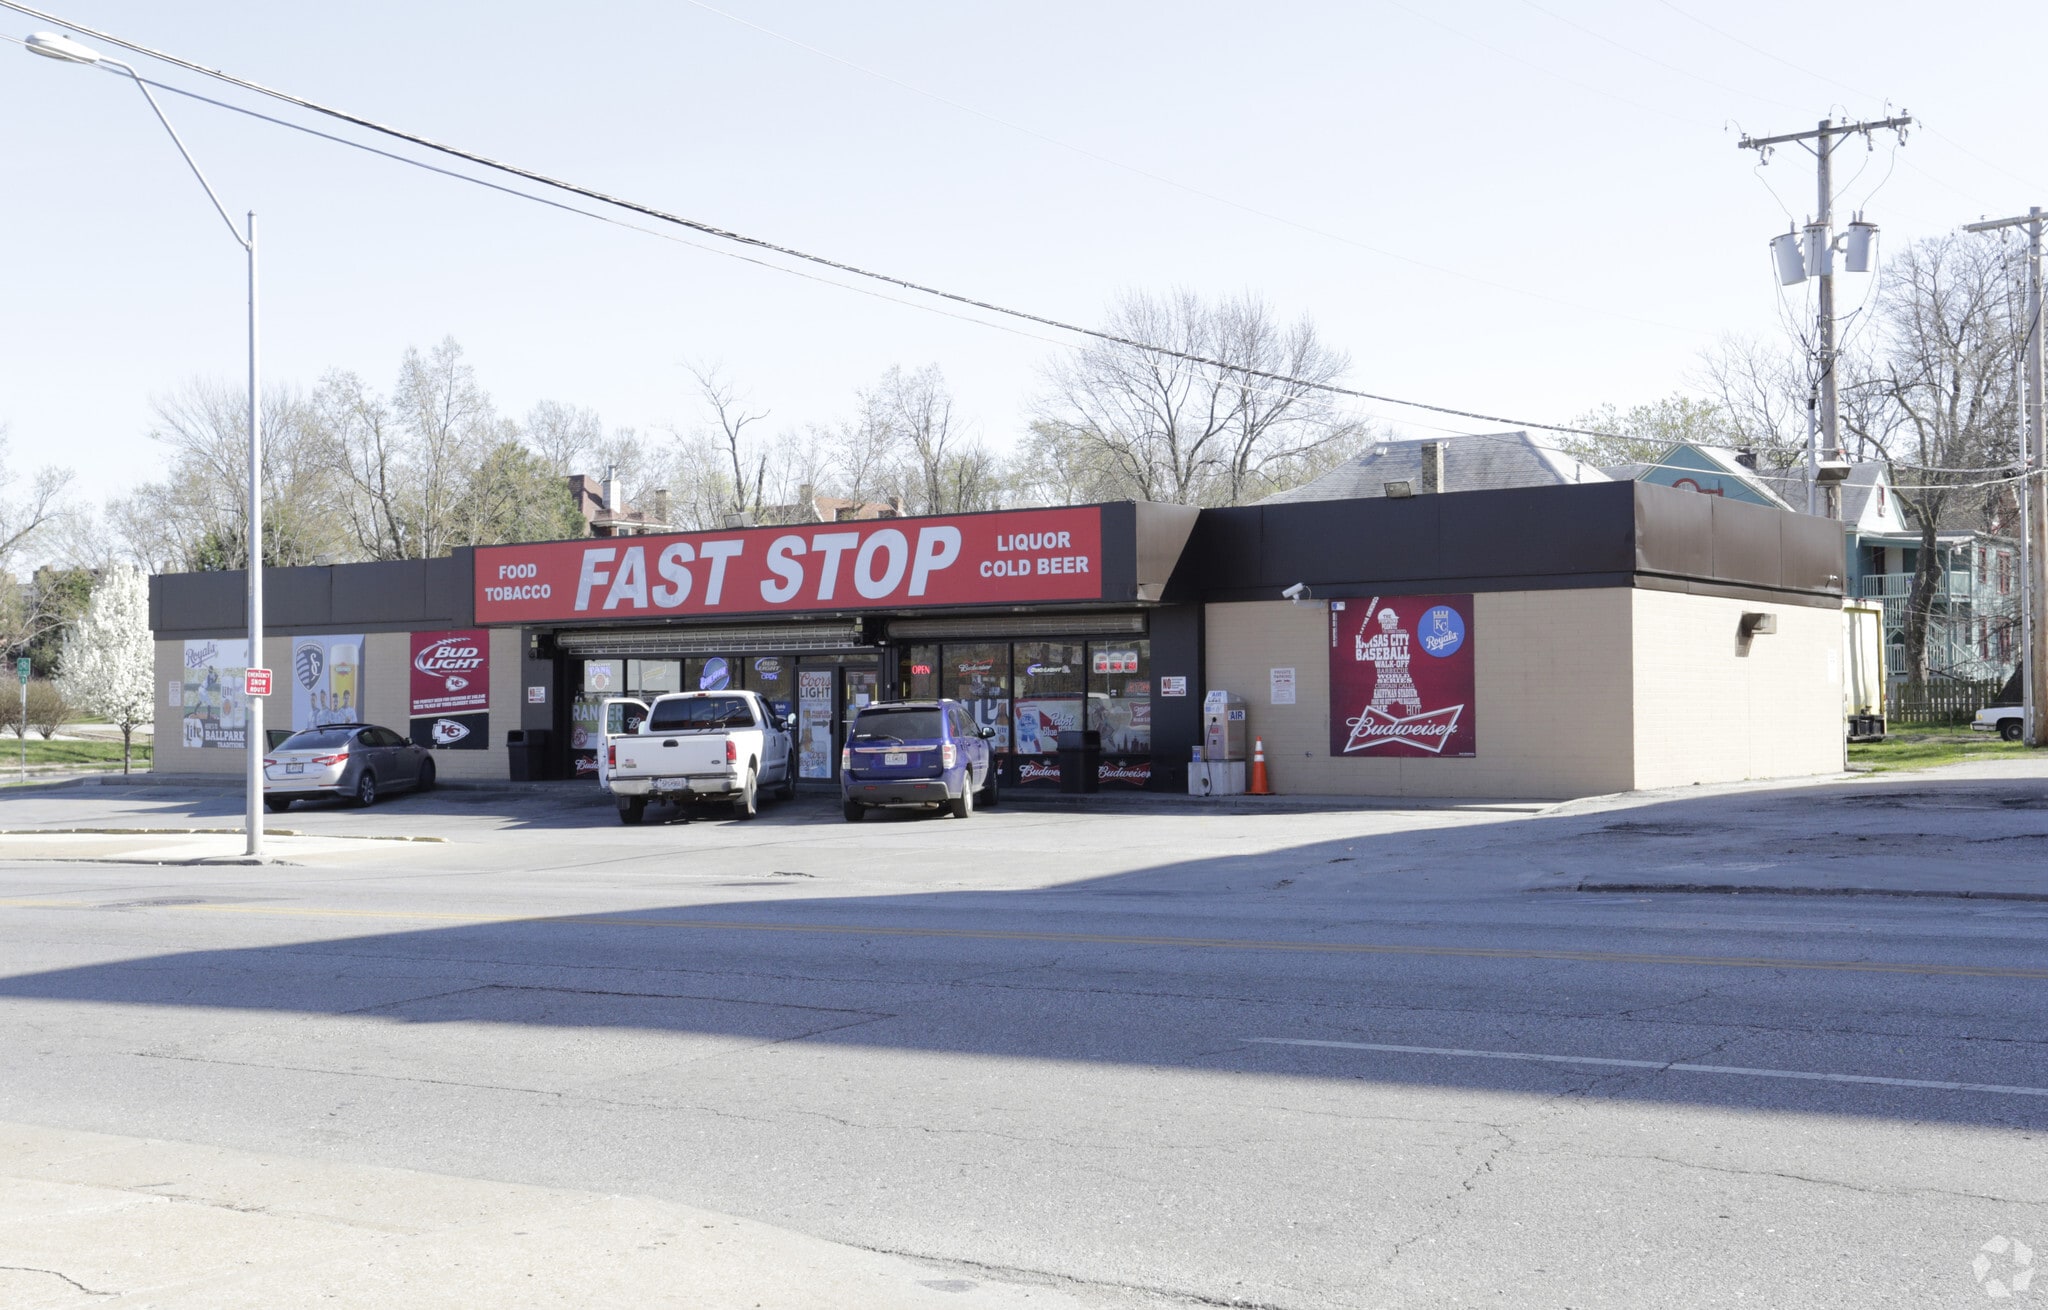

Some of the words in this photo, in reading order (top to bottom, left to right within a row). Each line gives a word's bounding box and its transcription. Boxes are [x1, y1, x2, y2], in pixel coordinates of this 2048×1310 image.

[997, 531, 1071, 552] LIQUOR
[498, 563, 537, 580] FOOD
[574, 538, 745, 611] FAST
[760, 525, 962, 604] STOP
[980, 559, 1031, 578] COLD
[1037, 556, 1089, 575] BEER
[484, 584, 551, 602] TOBACCO
[1355, 634, 1388, 648] KANSAS
[1390, 633, 1409, 647] CITY
[1426, 630, 1459, 651] Royals
[186, 641, 217, 669] Royals
[434, 646, 479, 659] BUD
[1355, 646, 1410, 661] BASEBALL
[422, 658, 484, 670] LIGHT
[911, 665, 931, 675] OPEN
[1374, 660, 1410, 668] WALK-OFF
[251, 678, 266, 686] SNOW
[800, 673, 831, 687] Coors
[800, 687, 831, 698] LIGHT
[572, 704, 623, 721] RANER
[1050, 711, 1075, 727] Pabst
[1230, 711, 1243, 720] AIR
[186, 723, 202, 742] Lite
[441, 724, 461, 738] KC
[1043, 726, 1058, 737] Blue
[1346, 717, 1458, 738] Budweiser
[205, 730, 246, 742] BALLPARK
[1018, 764, 1061, 778] Budwe
[1098, 765, 1151, 779] Budweiser
